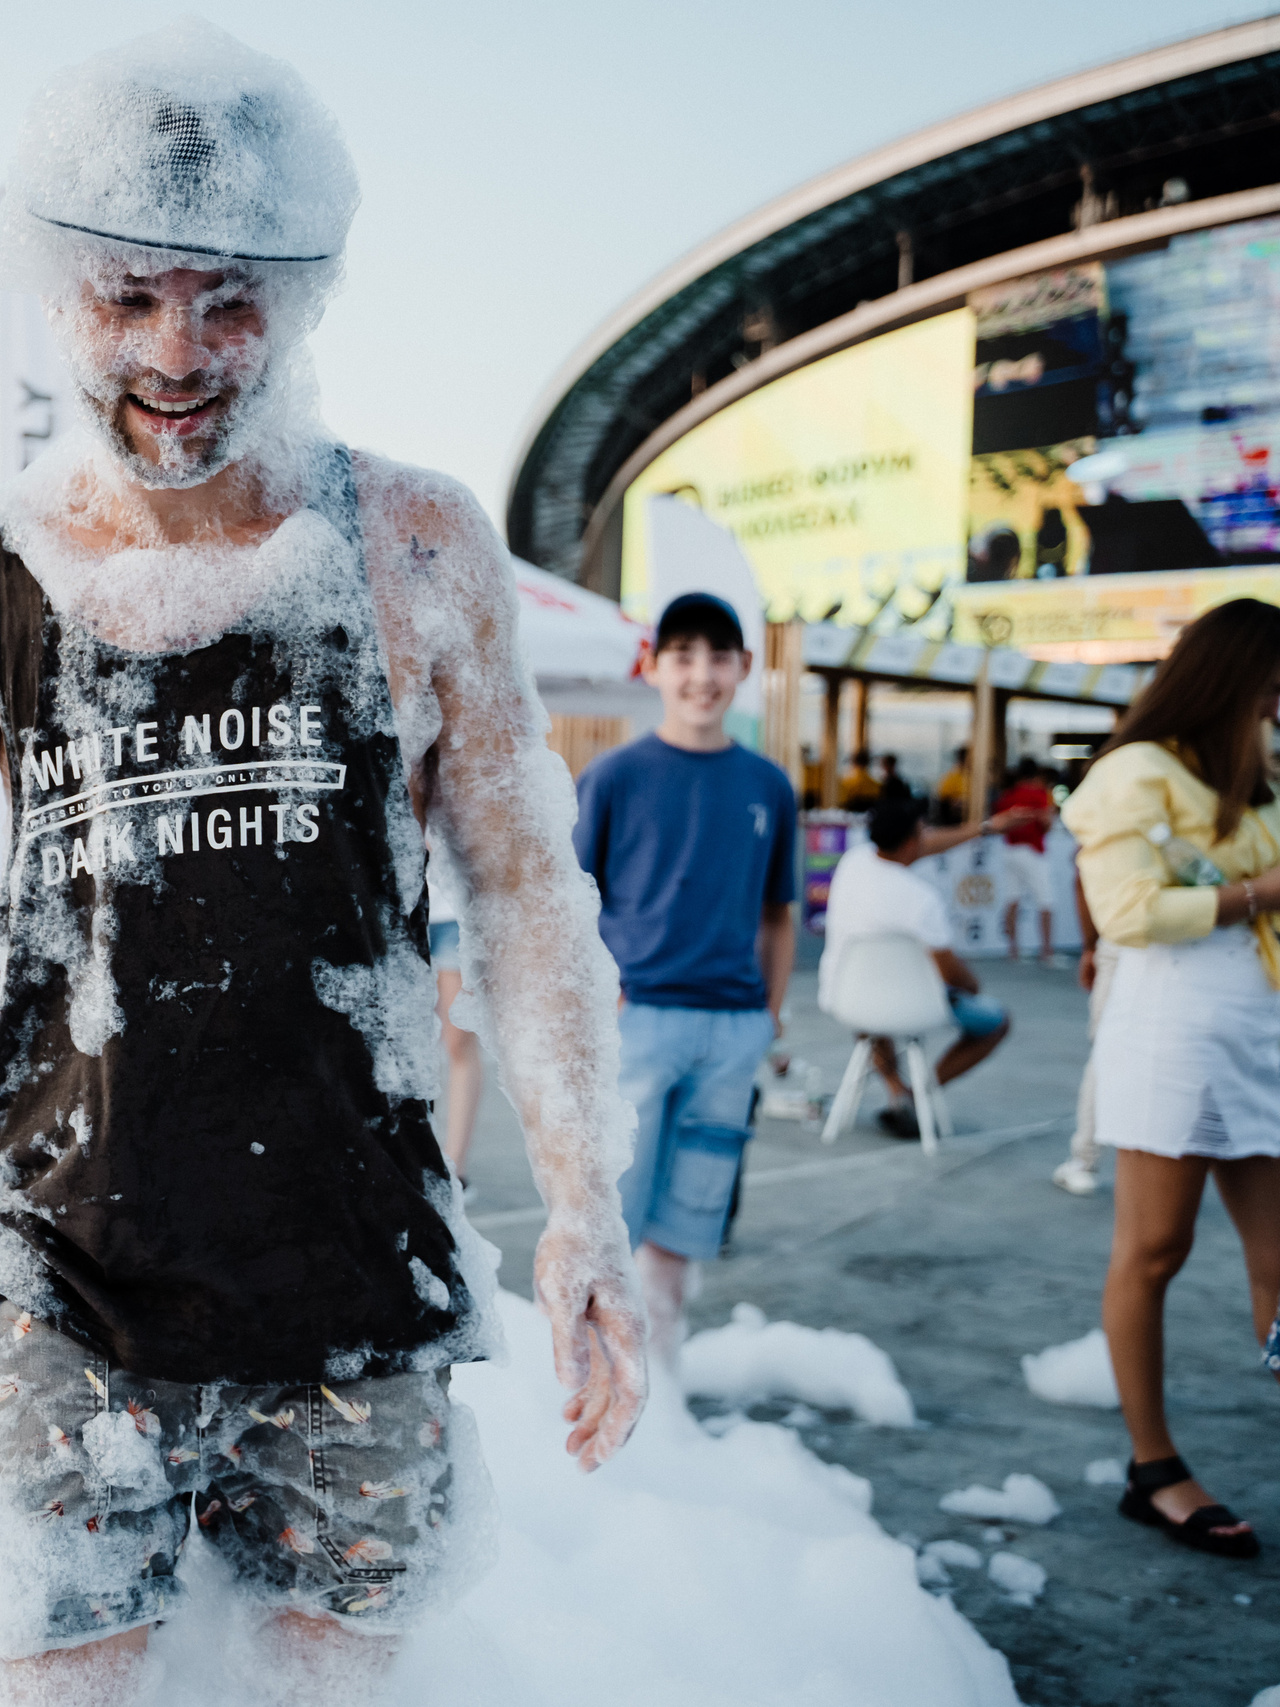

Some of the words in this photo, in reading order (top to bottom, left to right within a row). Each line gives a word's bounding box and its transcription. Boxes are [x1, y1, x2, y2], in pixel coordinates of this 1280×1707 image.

[18, 378, 53, 471] LY
[30, 722, 159, 791] WHITE
[184, 705, 322, 755] NOISE
[112, 788, 131, 799] TO
[142, 782, 173, 794] YOU
[185, 778, 204, 788] BY
[215, 772, 256, 784] ONLY
[157, 803, 321, 855] NIGHTS
